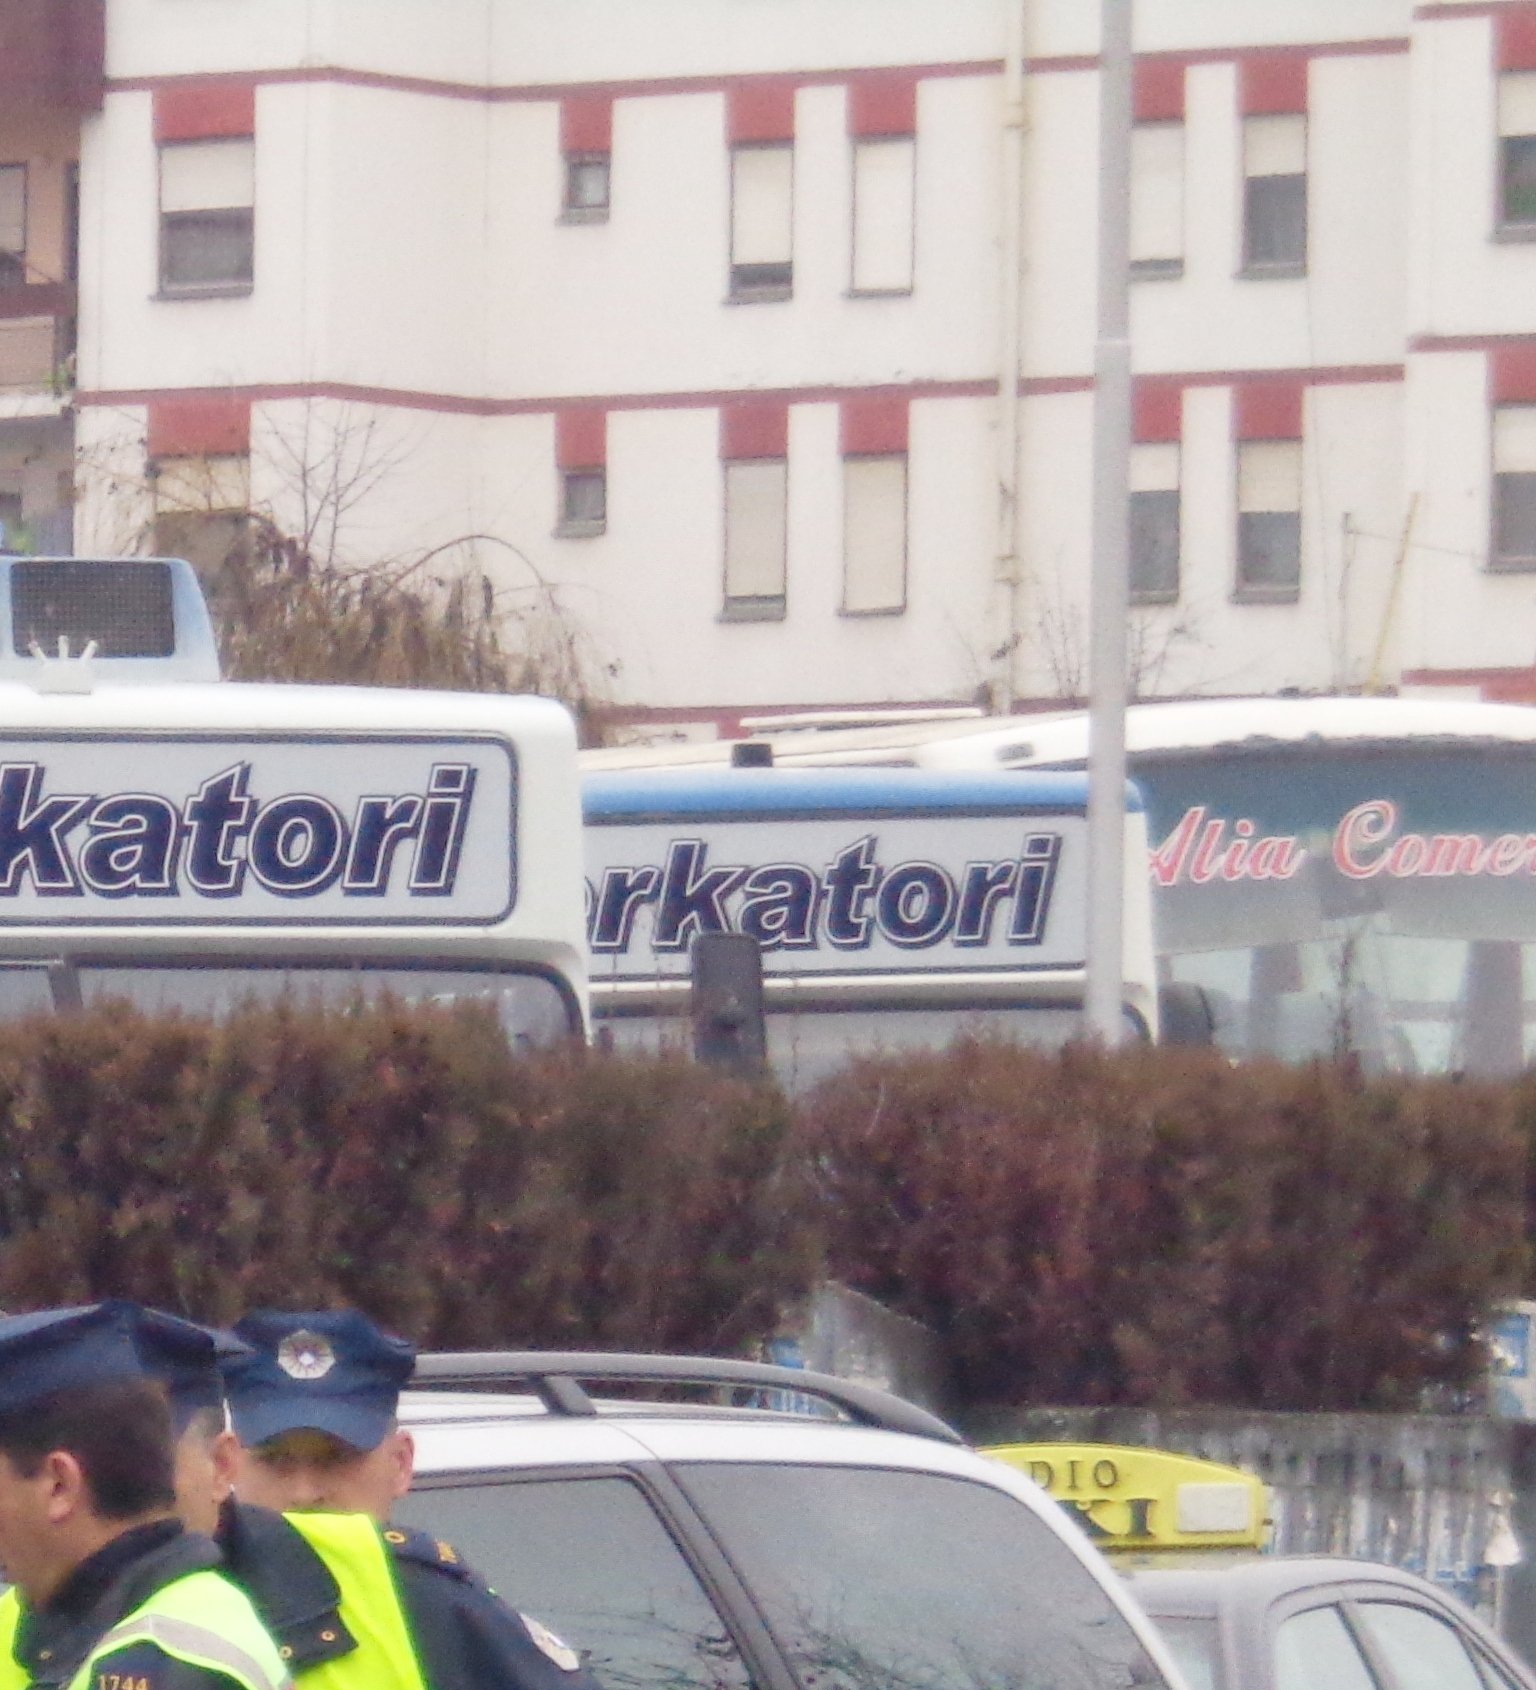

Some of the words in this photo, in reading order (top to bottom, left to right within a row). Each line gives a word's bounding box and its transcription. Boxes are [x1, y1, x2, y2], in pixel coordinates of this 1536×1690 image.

[585, 833, 1063, 954] rkatori
[1025, 1459, 1119, 1490] DIO
[1054, 1497, 1158, 1538] XI
